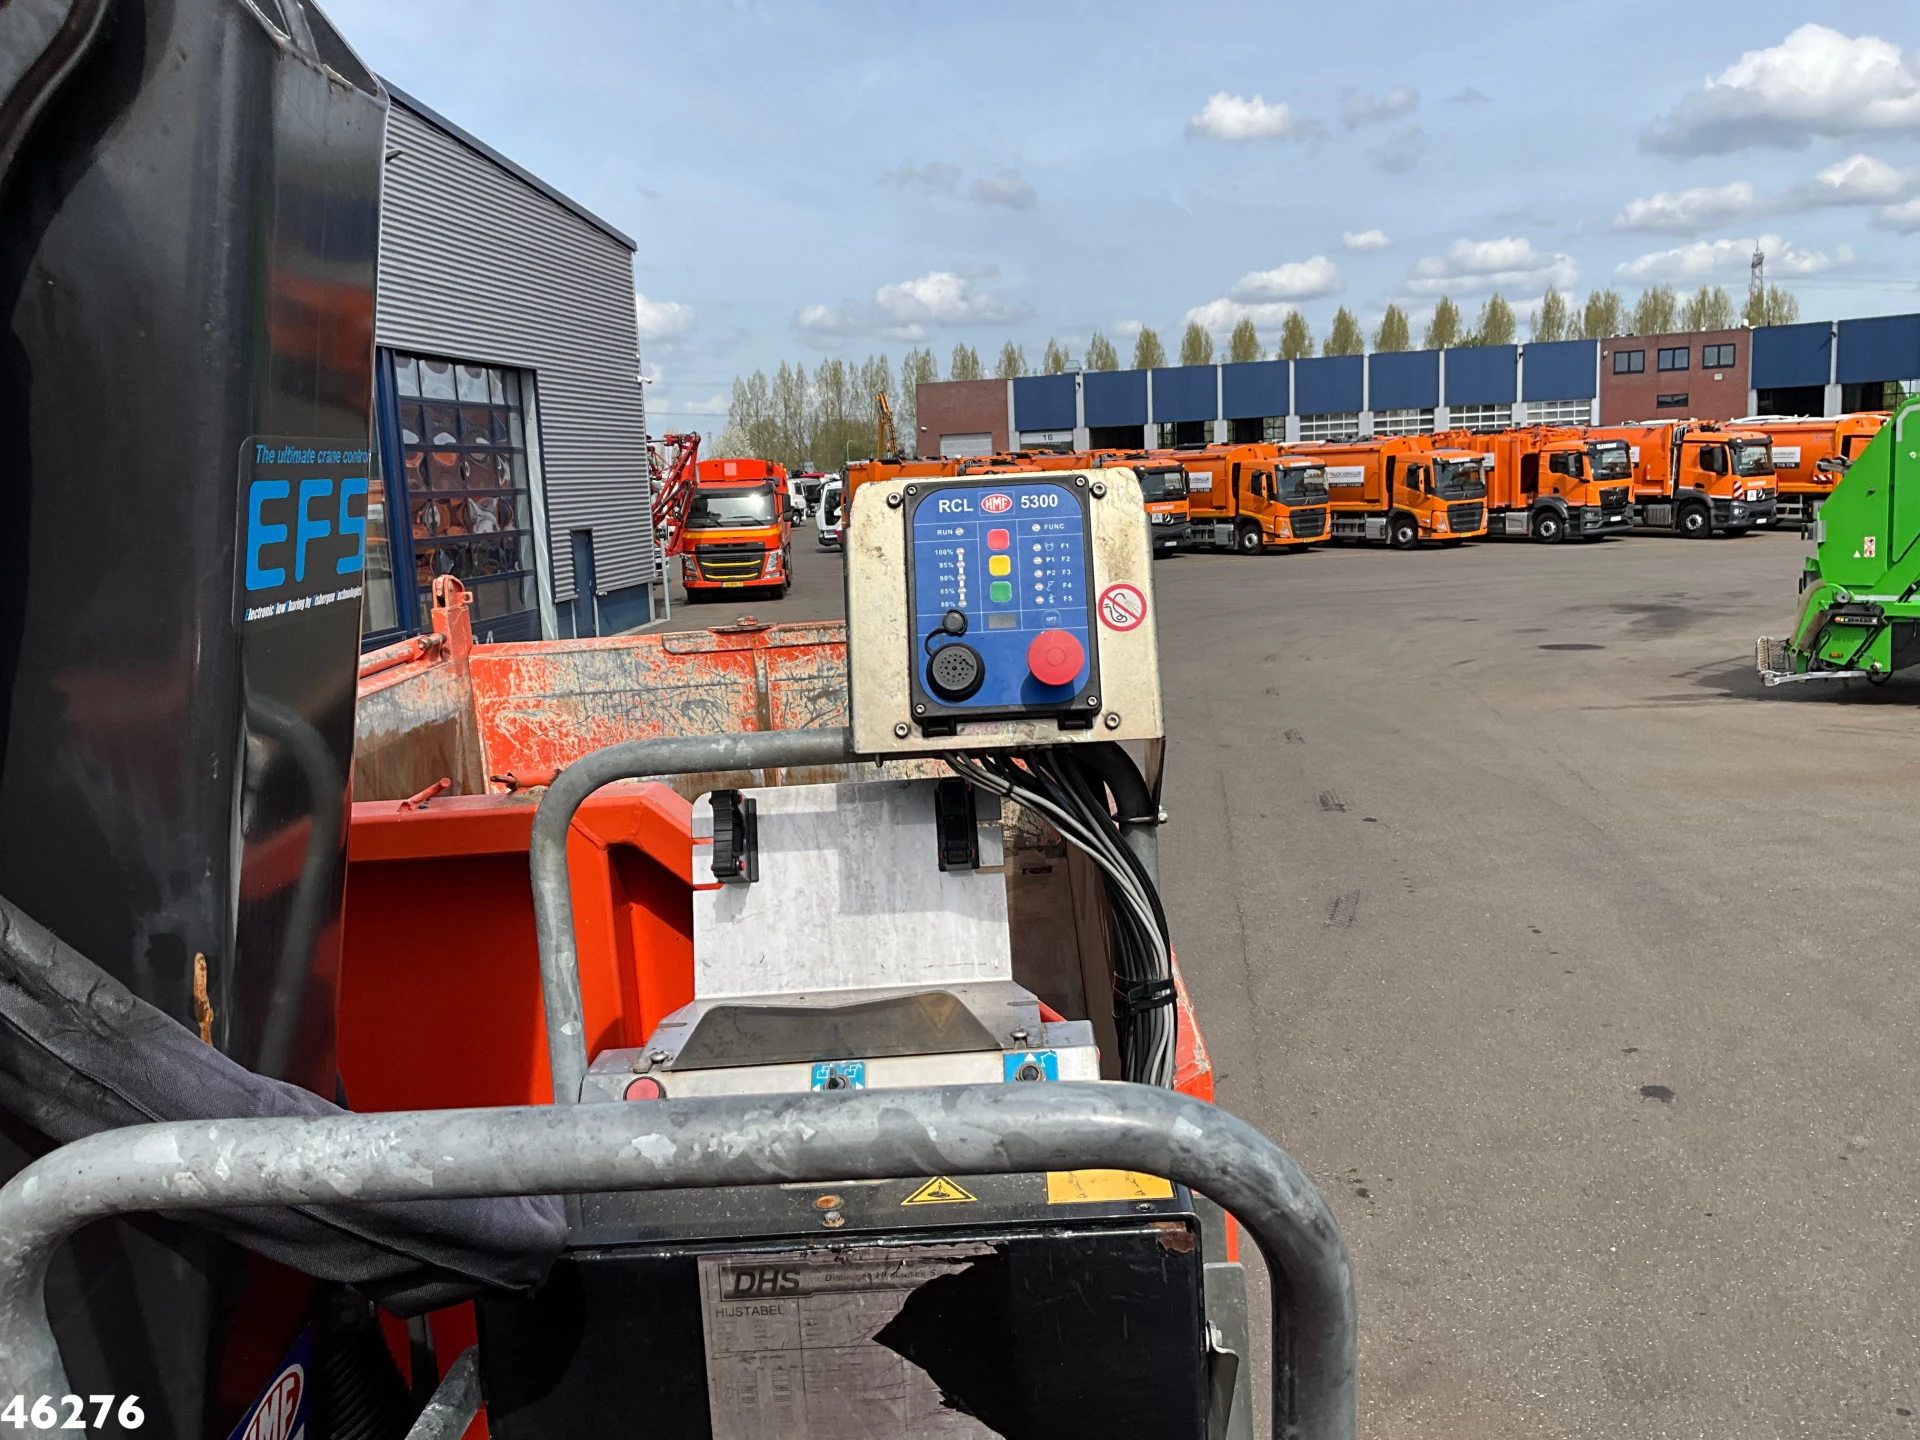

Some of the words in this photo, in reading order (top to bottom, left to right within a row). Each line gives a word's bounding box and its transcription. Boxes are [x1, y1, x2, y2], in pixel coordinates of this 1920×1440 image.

[256, 445, 275, 464] The
[277, 446, 315, 464] ultimate
[318, 450, 341, 464] crane
[938, 499, 974, 513] RCL
[983, 496, 1009, 511] HMF
[1020, 494, 1058, 509] 5300
[245, 477, 368, 591] EFS
[244, 603, 274, 621] Electronic
[733, 1269, 800, 1294] DHS
[715, 1304, 785, 1318] HIJSTABEL
[249, 1376, 295, 1440] MF
